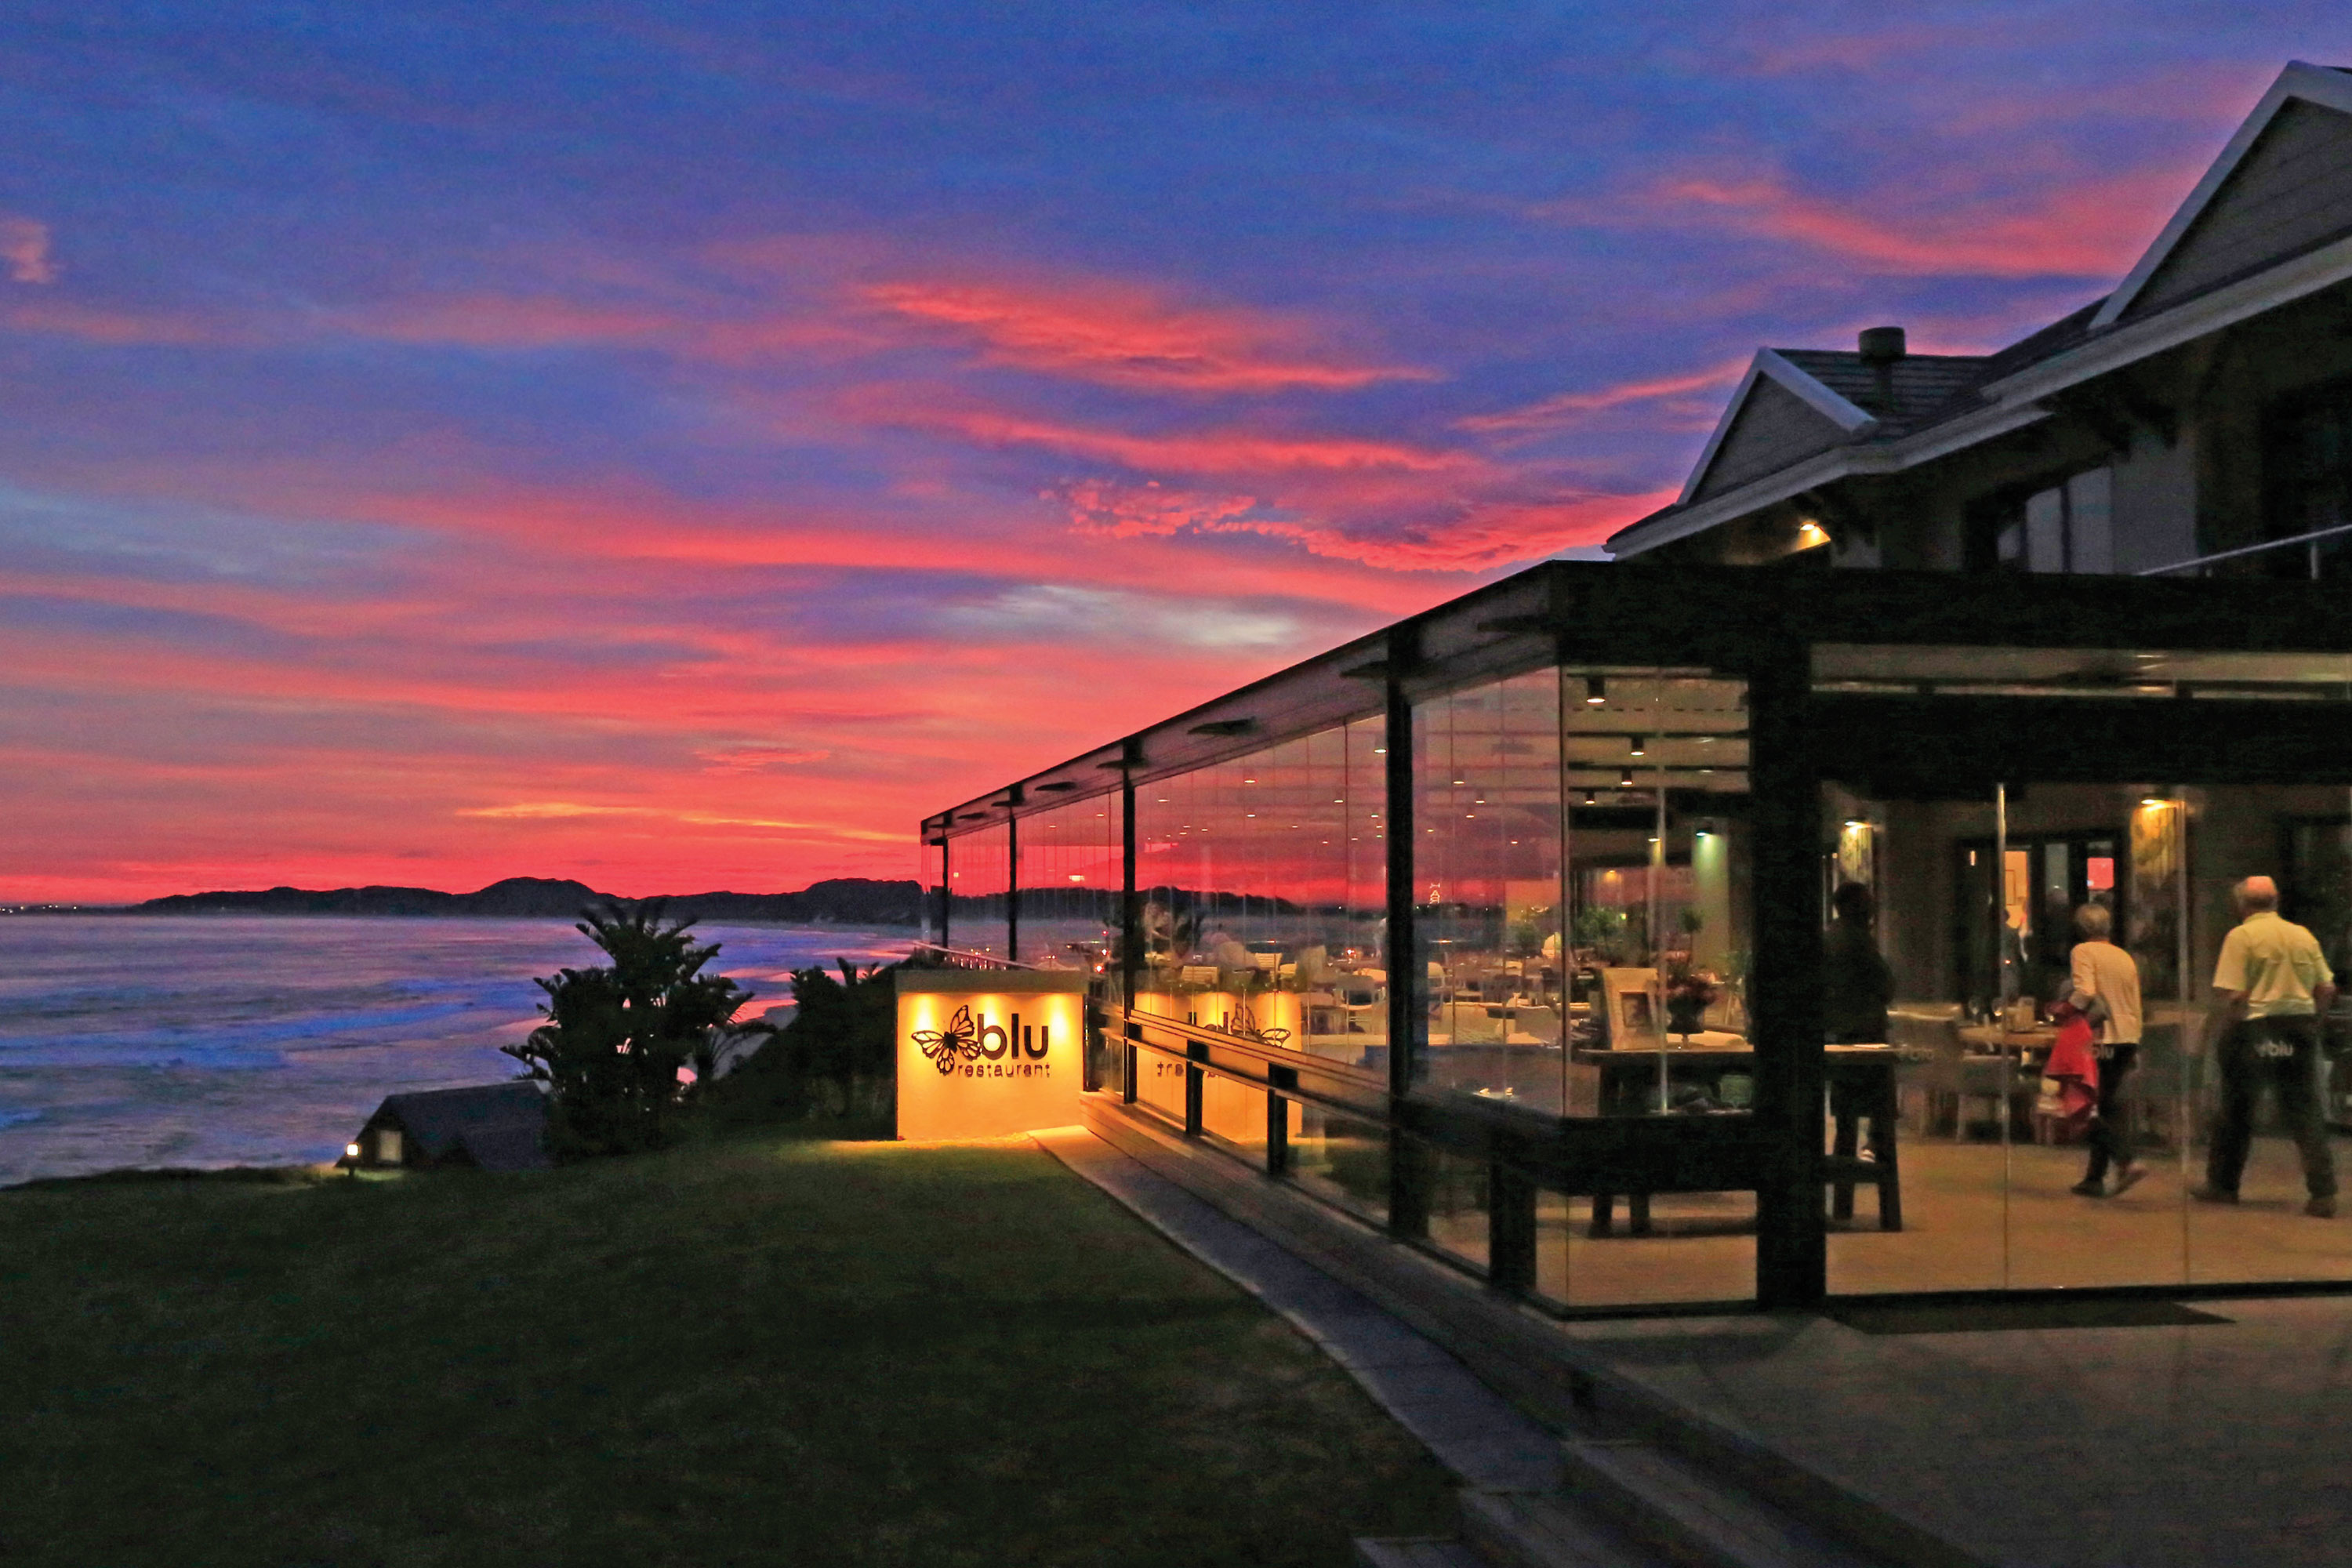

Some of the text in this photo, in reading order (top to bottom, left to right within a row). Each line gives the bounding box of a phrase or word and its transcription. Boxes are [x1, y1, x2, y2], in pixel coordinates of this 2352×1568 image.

[977, 1013, 1049, 1061] blu
[2268, 1040, 2293, 1057] blu
[957, 1062, 1051, 1078] restaurant
